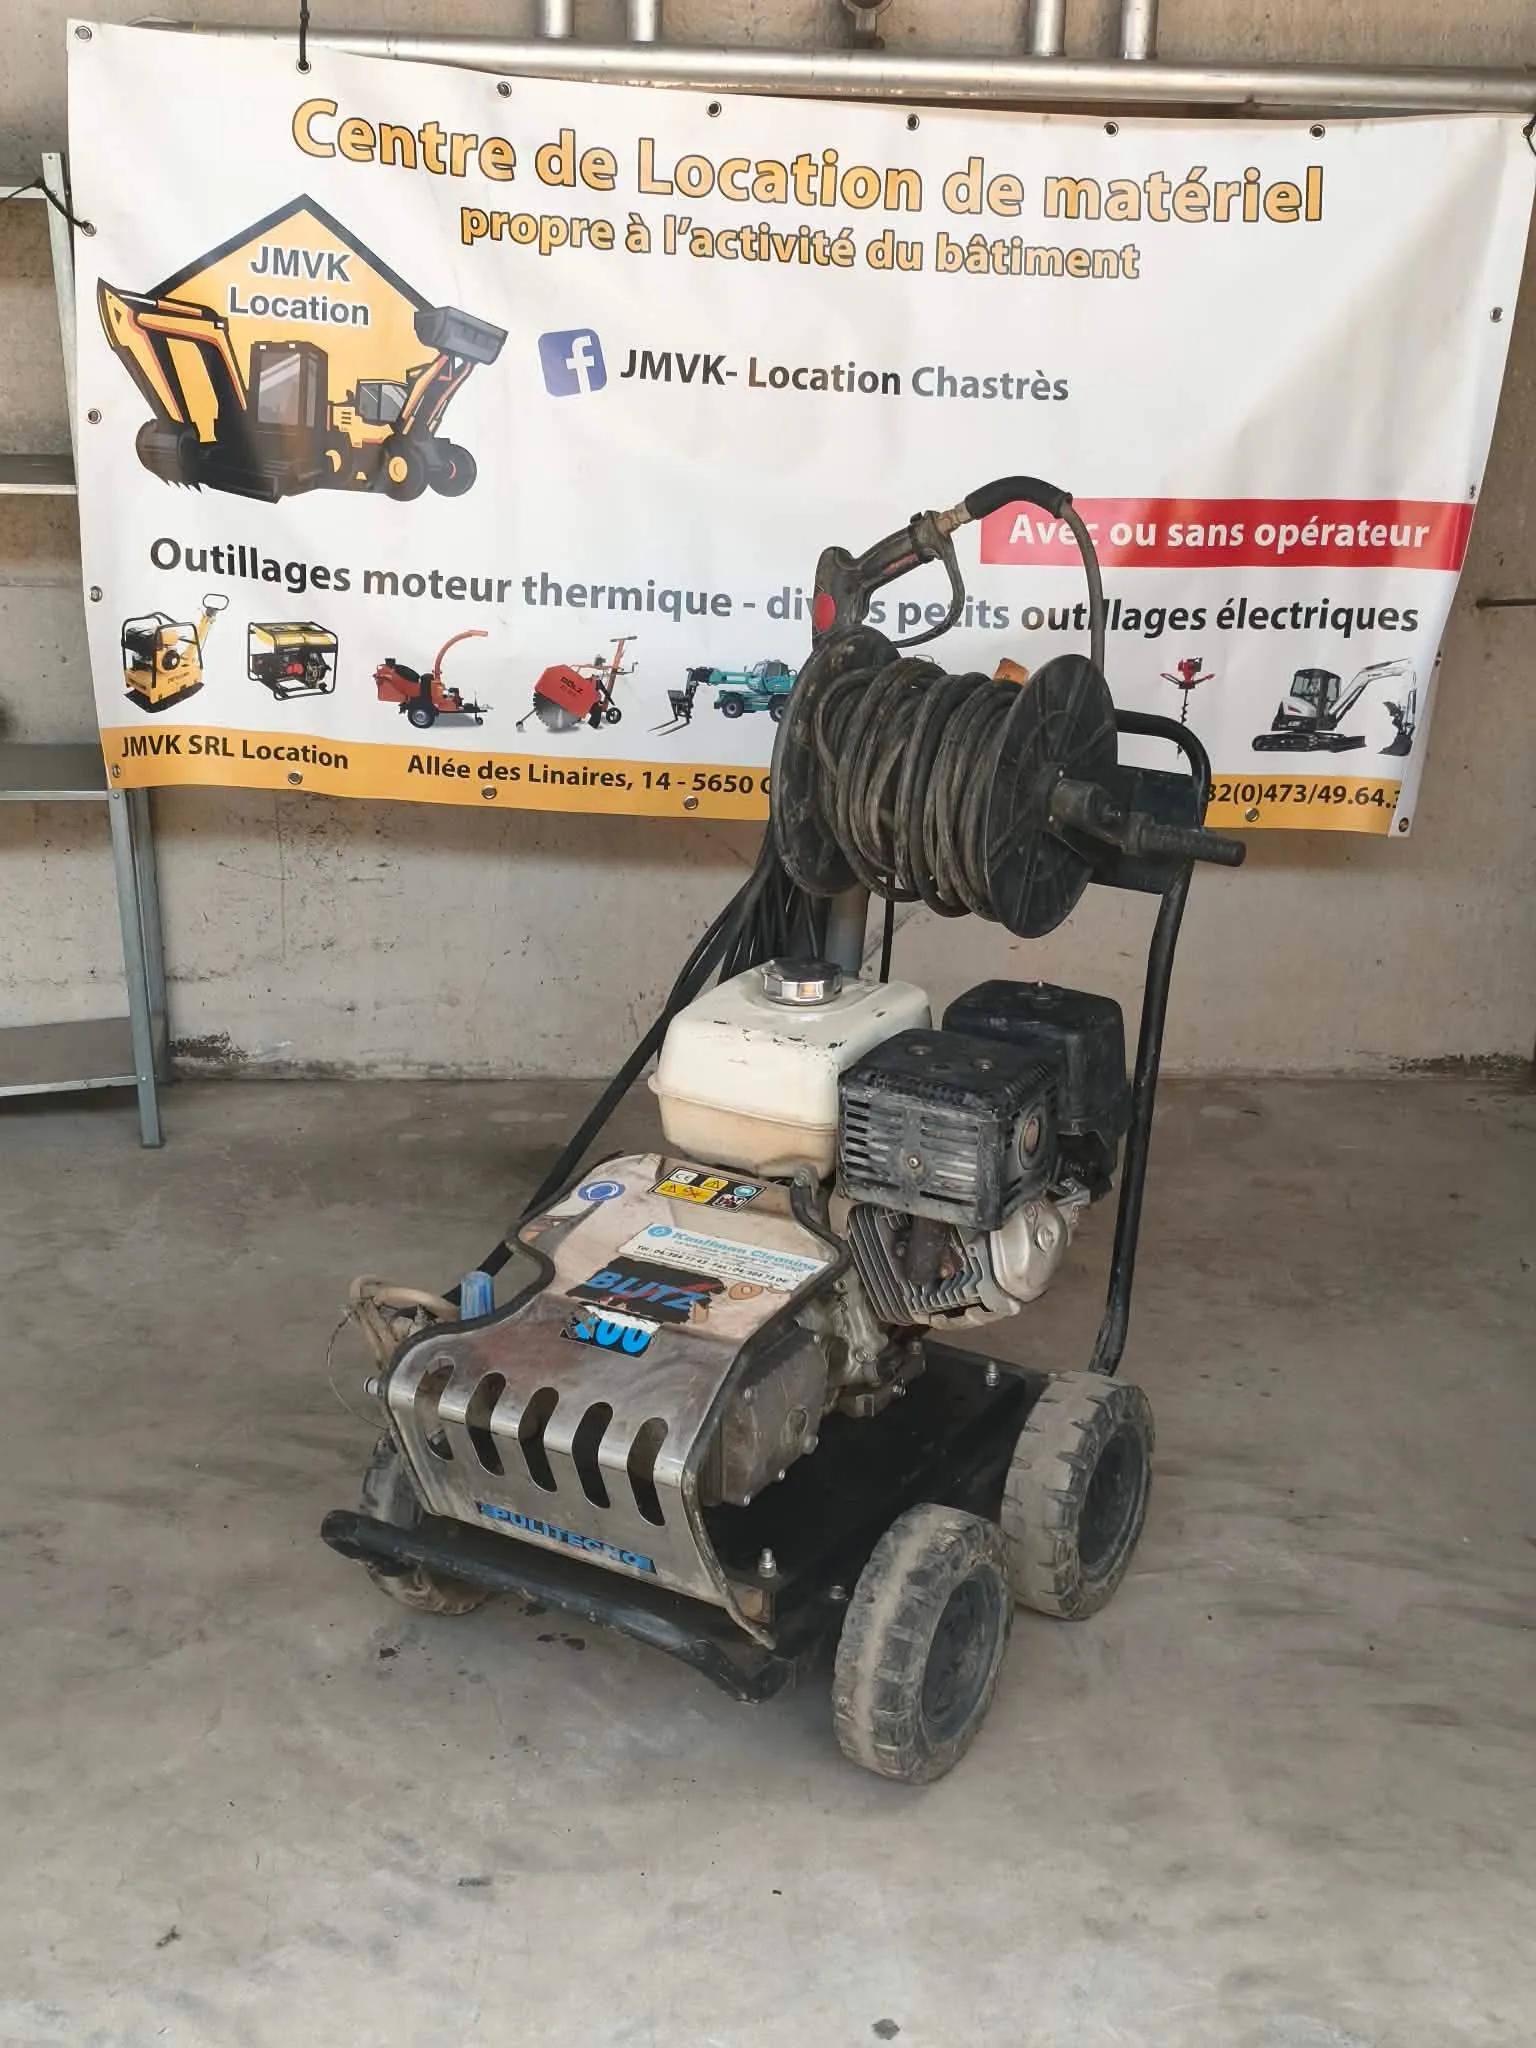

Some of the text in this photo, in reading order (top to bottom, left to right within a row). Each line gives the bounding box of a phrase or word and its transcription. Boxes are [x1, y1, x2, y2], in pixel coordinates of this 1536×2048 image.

[292, 98, 1323, 223] Centre de Location de matériel
[460, 206, 1140, 279] propre à l'activité du bâtiment
[250, 245, 352, 283] JMVK
[229, 286, 370, 327] Location
[620, 349, 1070, 402] JMVK- Location Chastrès
[1109, 522, 1157, 547] ou
[1167, 521, 1245, 548] sans
[1253, 516, 1431, 554] opérateur
[149, 537, 351, 594] Outillages
[362, 569, 512, 604] moteur
[522, 571, 732, 622] thermique
[898, 595, 1010, 634] peits
[1216, 597, 1419, 638] électriques
[121, 735, 349, 769] JMVK SRL Location
[407, 754, 471, 779] Allée
[477, 760, 521, 782] des
[528, 763, 634, 791] Linaires,
[643, 771, 671, 790] 14
[691, 773, 754, 795] 5650
[584, 1271, 711, 1310] BLITZ
